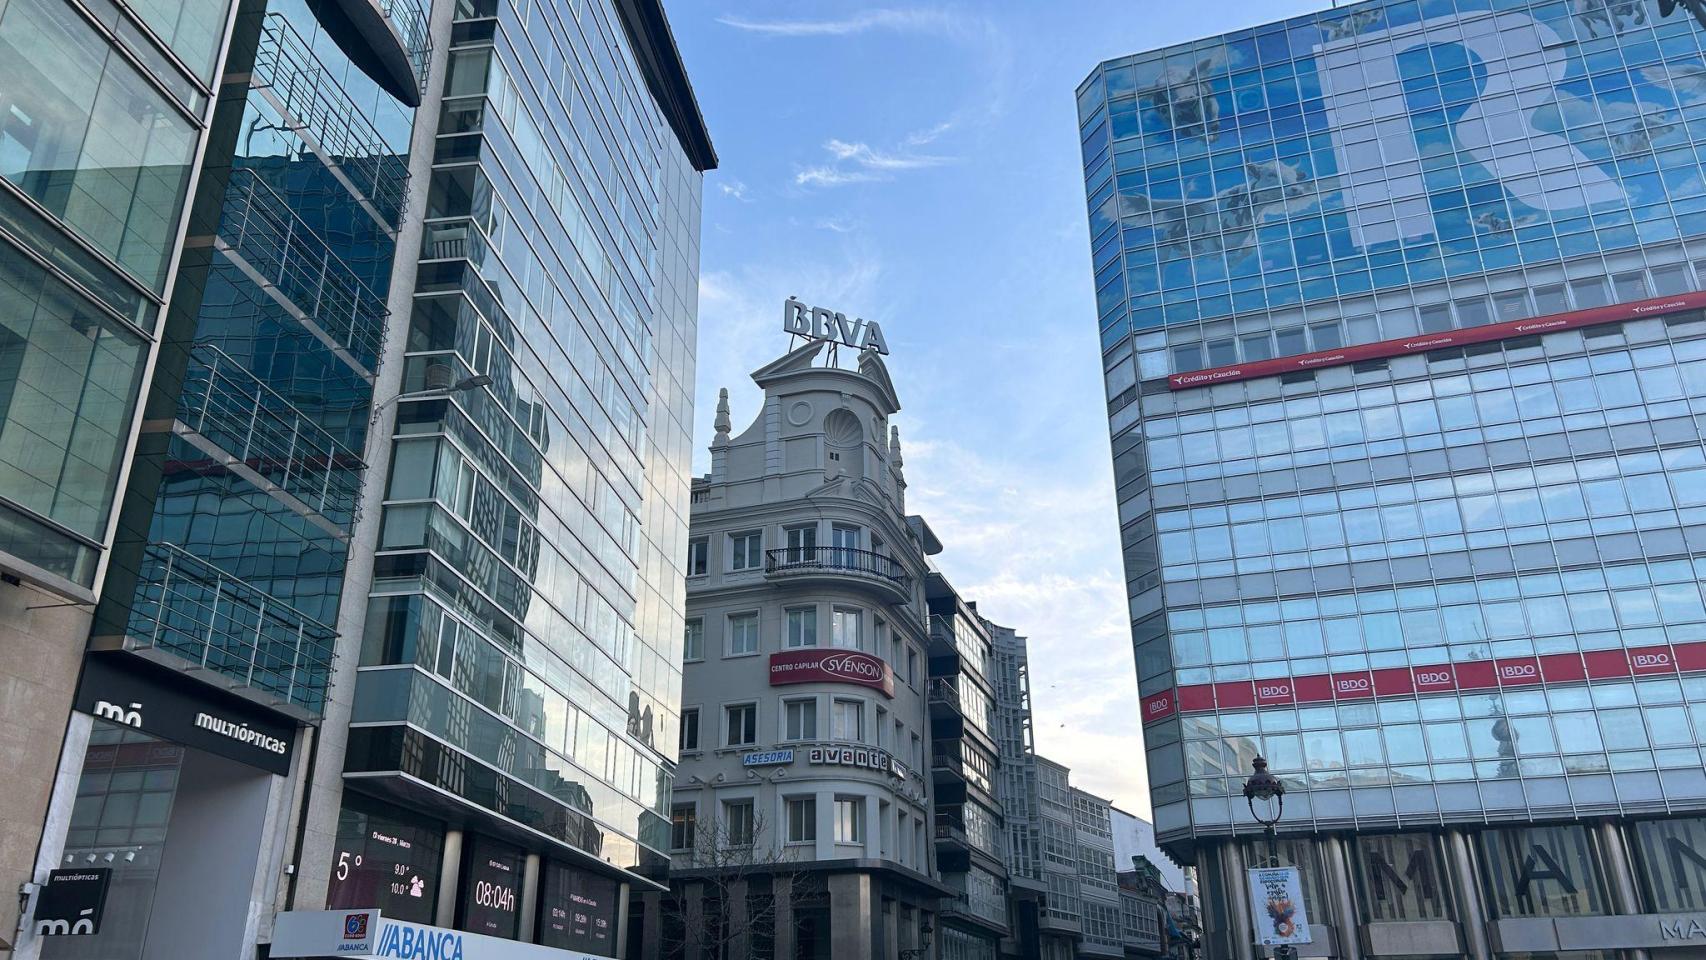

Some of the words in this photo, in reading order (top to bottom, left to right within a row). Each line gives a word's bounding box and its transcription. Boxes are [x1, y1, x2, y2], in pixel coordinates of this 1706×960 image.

[784, 299, 889, 356] BBVA
[1183, 374, 1208, 384] Crédito
[1213, 369, 1241, 378] Caución
[771, 664, 794, 673] CENTRO
[795, 661, 820, 670] CAPILAR
[828, 654, 880, 678] SVENSON
[1638, 653, 1669, 666] BDO
[1504, 664, 1535, 676] BDO
[1420, 672, 1450, 683] BDO
[1263, 685, 1290, 696] BDO
[1341, 679, 1369, 690] BDO
[1151, 698, 1168, 711] BDO
[744, 750, 792, 764] ASESORIA
[810, 749, 887, 767] avante
[476, 880, 514, 912] 08:04h
[341, 943, 368, 951] ABANCA
[386, 925, 463, 960] ABANCA
